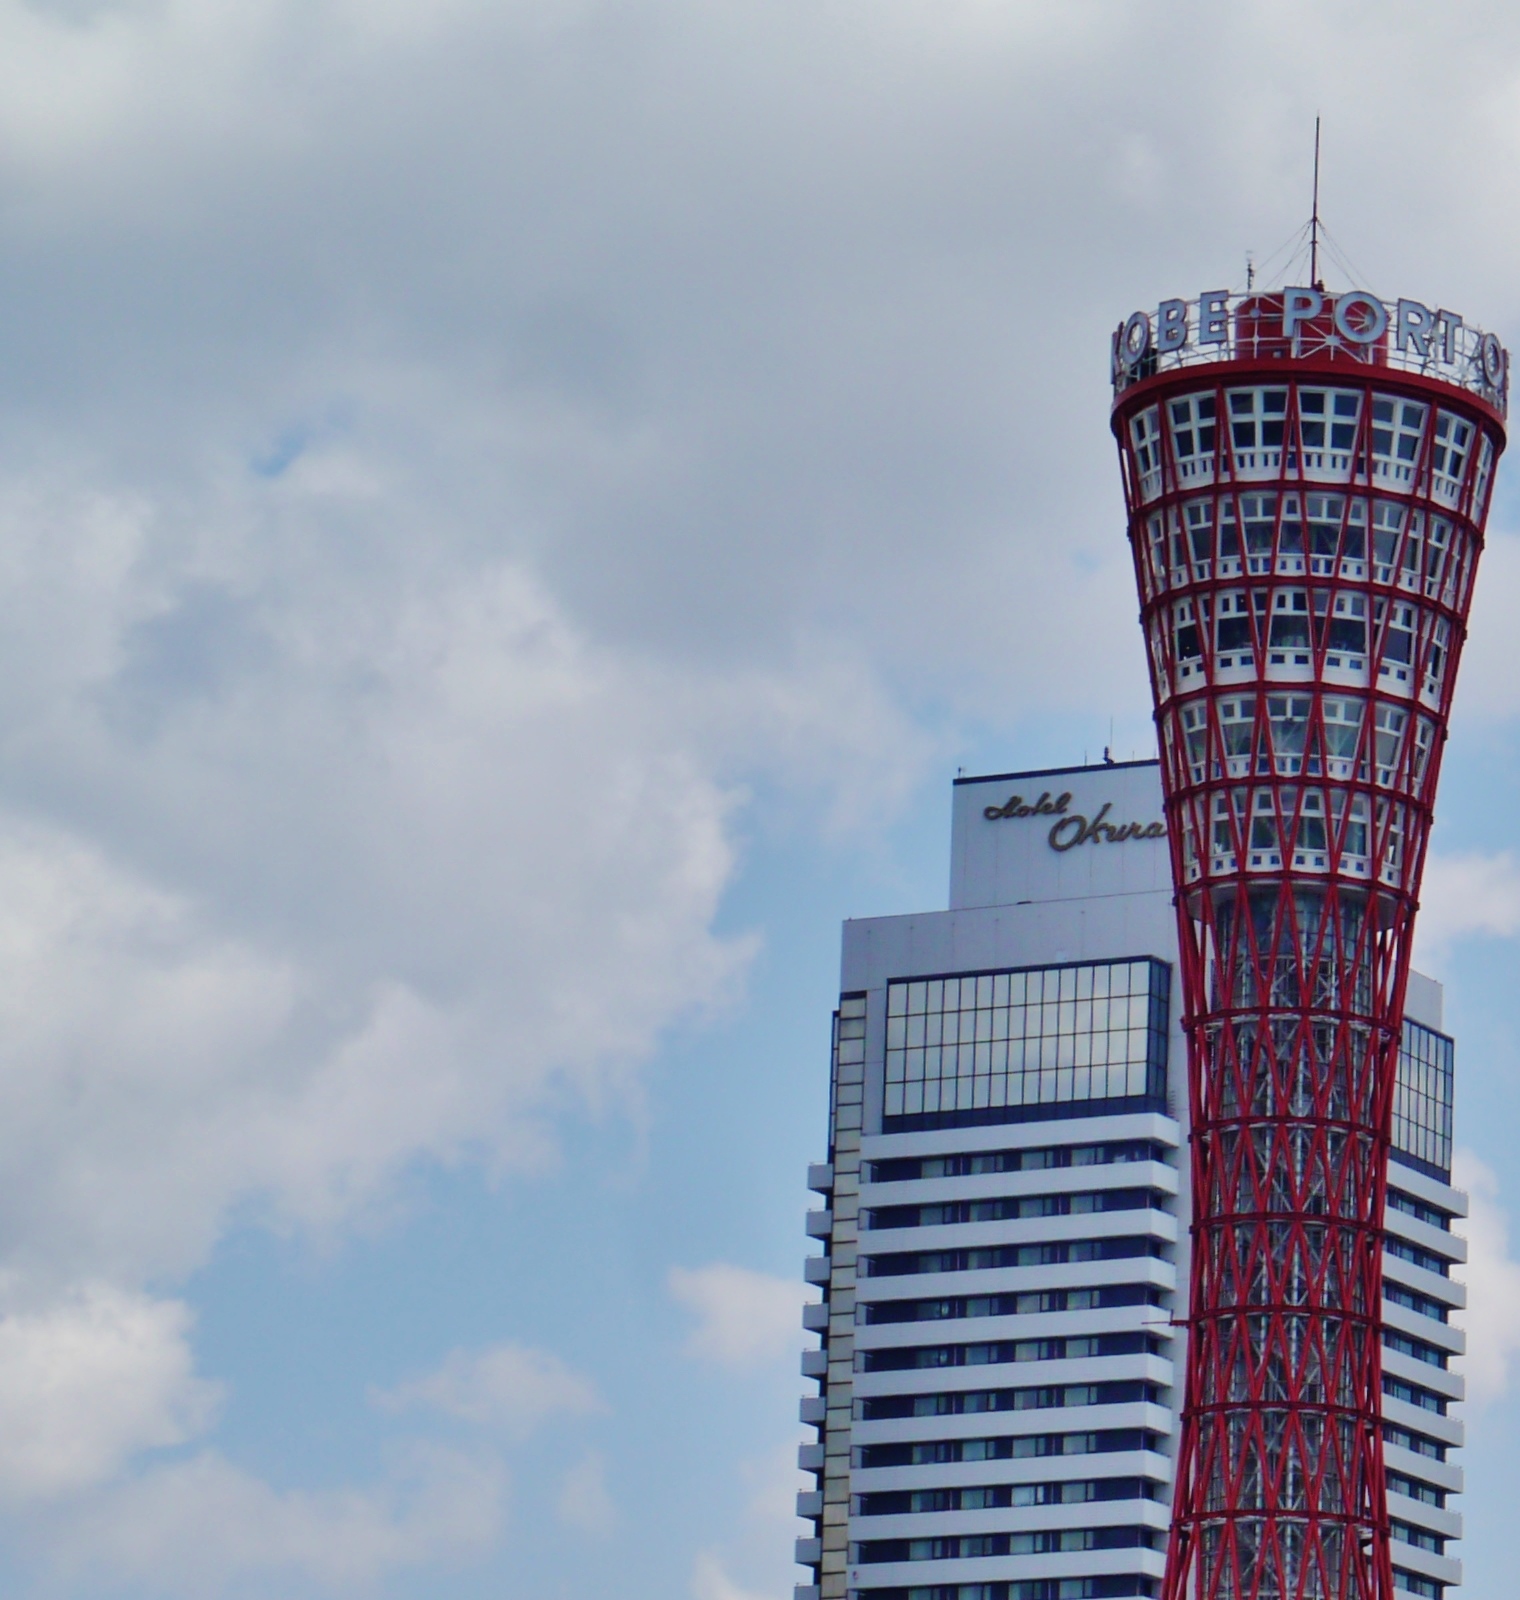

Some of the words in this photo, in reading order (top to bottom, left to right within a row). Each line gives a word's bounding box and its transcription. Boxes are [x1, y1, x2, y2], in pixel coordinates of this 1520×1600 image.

[1111, 289, 1230, 385] KOBE
[1282, 286, 1463, 364] PORT
[984, 791, 1073, 821] Hotel
[1048, 802, 1168, 852] Okura
